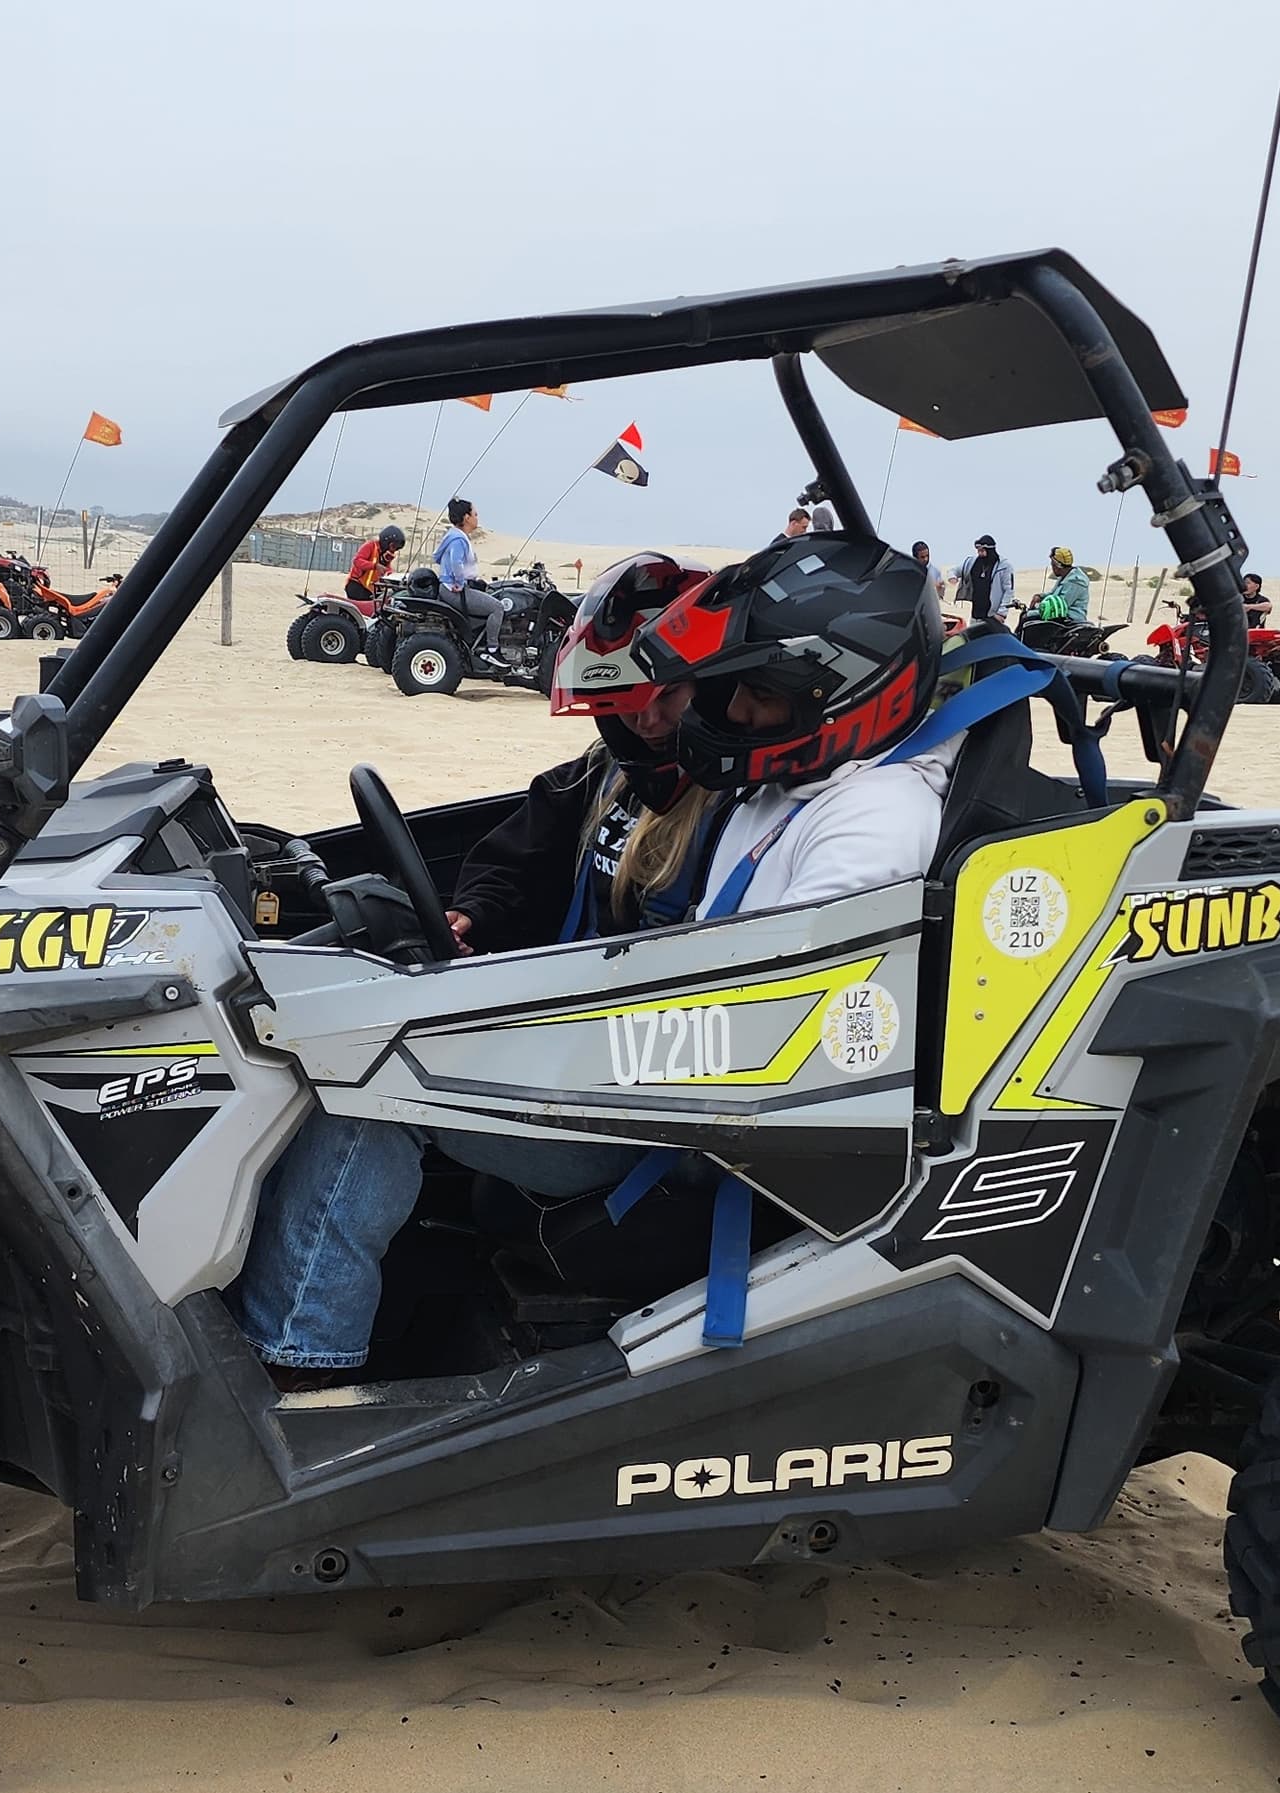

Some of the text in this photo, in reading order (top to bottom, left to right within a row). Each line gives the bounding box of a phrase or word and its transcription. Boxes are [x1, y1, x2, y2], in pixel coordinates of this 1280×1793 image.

[1010, 876, 1037, 893] UZ
[1008, 931, 1044, 948] 210
[845, 990, 871, 1010] UZ
[606, 1004, 731, 1087] UZ210
[846, 1044, 879, 1065] 210
[99, 1057, 199, 1105] EPS
[100, 1087, 201, 1121] POWER STEERING
[922, 1140, 1085, 1241] S
[616, 1434, 953, 1507] POLARIS
